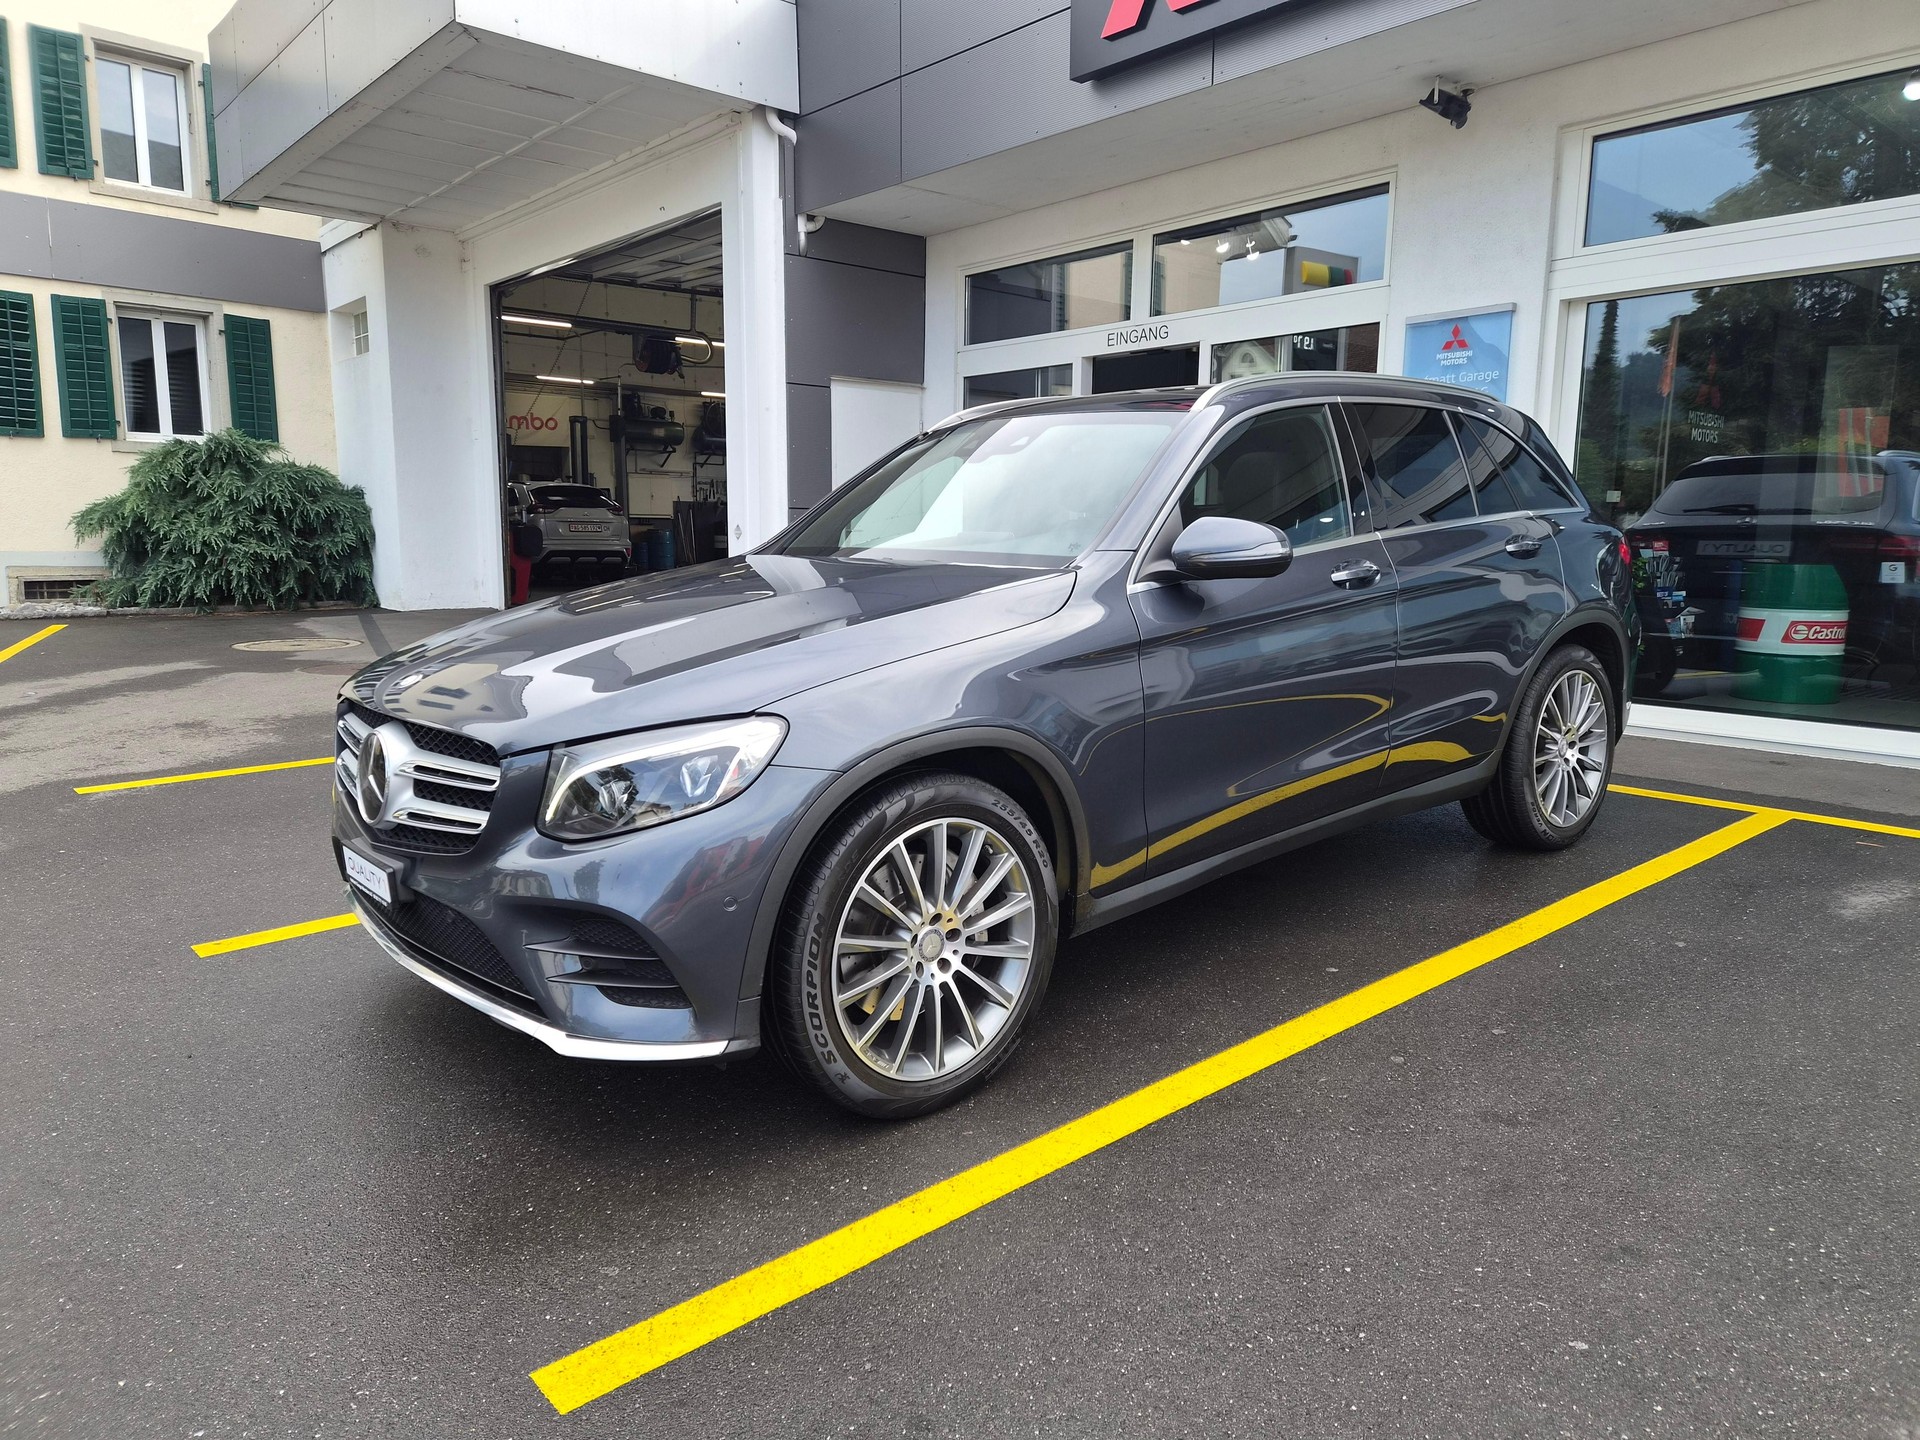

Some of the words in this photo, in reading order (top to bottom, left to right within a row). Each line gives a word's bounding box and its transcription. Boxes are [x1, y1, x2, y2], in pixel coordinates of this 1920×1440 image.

[1107, 325, 1168, 346] EINGANG
[1436, 350, 1473, 360] MITSUBISHI
[1440, 357, 1467, 366] MOTORS
[1459, 370, 1499, 383] Garage
[507, 412, 558, 430] mbo
[1688, 410, 1724, 428] MITSUBISHI
[1691, 428, 1718, 443] MOTORS
[1809, 625, 1847, 639] Castrol
[991, 799, 1033, 836] 255/45
[1032, 839, 1048, 868] R20
[806, 912, 838, 1065] SCORPION
